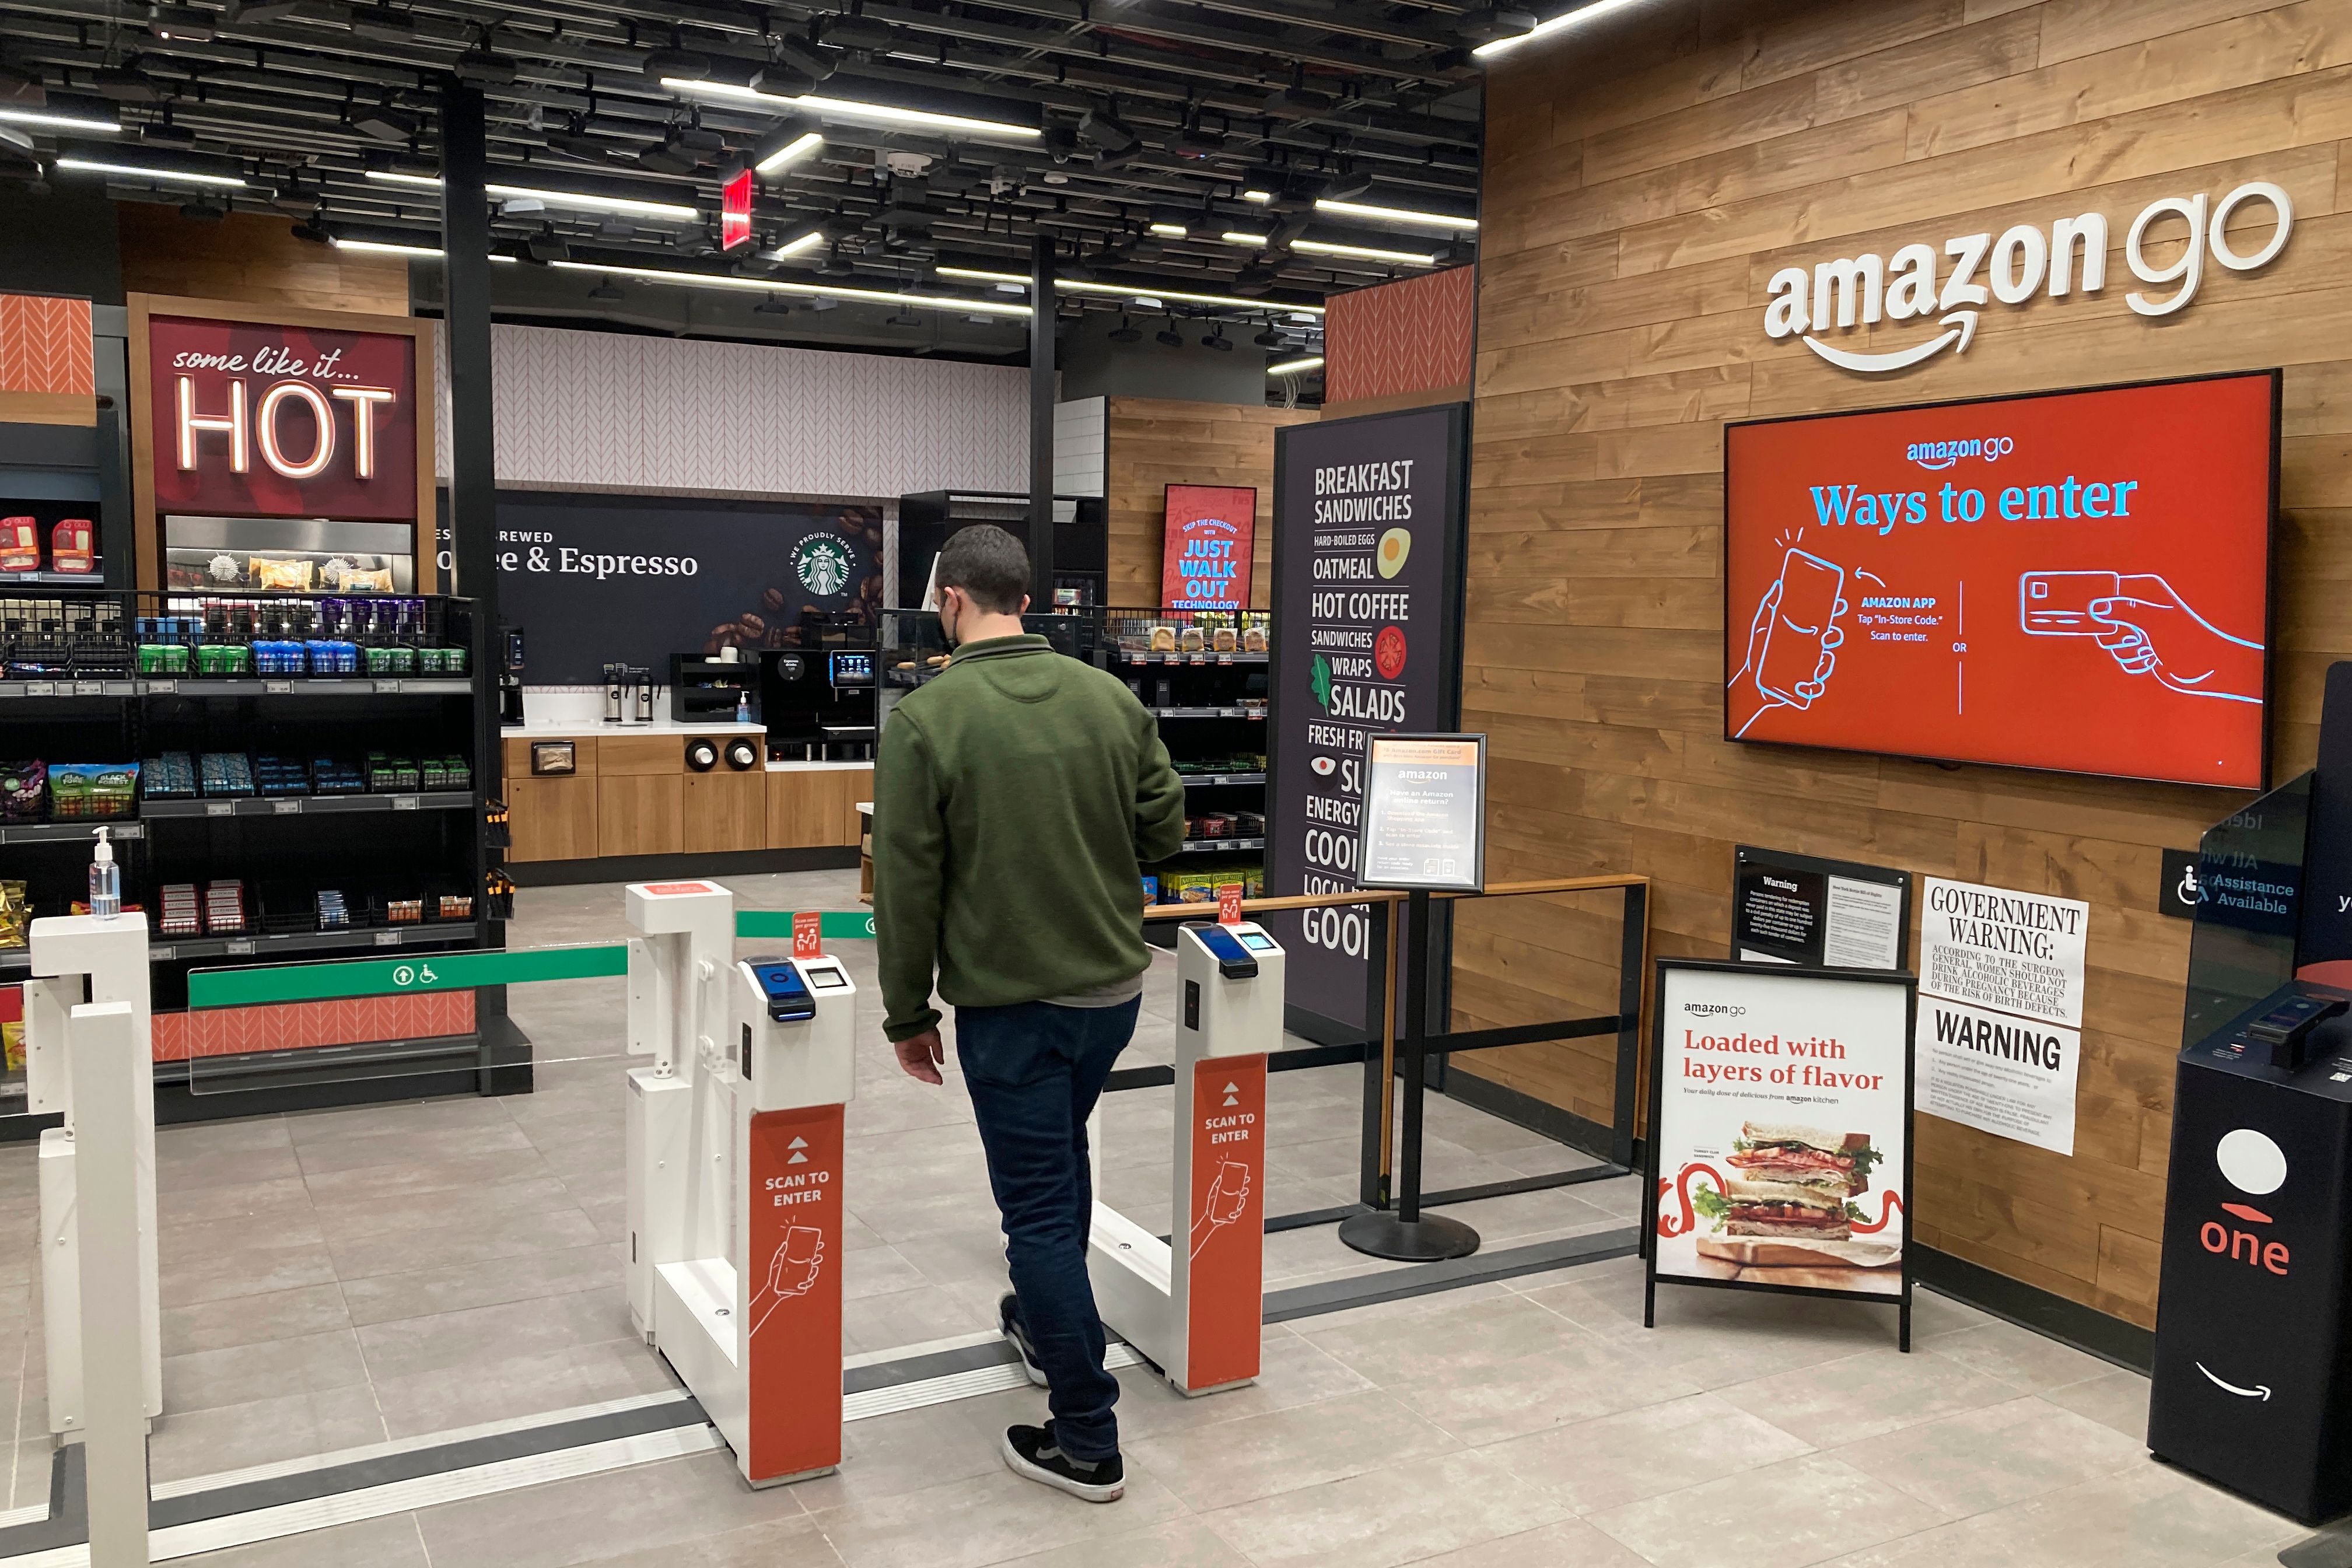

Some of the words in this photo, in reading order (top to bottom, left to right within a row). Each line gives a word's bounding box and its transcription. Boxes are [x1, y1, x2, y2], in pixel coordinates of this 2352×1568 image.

[1763, 212, 2108, 339] amazon
[2125, 181, 2295, 317] go
[173, 351, 249, 372] some
[252, 346, 309, 376] like
[312, 348, 359, 380] it...
[174, 373, 397, 480] HOT
[1907, 438, 1981, 461] amazon
[1984, 436, 2014, 463] go
[1315, 459, 1413, 496] BREAKFAST
[1314, 494, 1412, 524] SANDWICHES
[1809, 484, 1927, 536] Ways
[1938, 481, 1986, 523] to
[1998, 475, 2138, 521] enter
[495, 530, 553, 543] REWED
[1182, 521, 1196, 533] SKIP
[1209, 519, 1238, 534] CHECKOUT
[790, 546, 800, 559] WE
[799, 531, 835, 547] PROUDLY
[836, 537, 856, 559] SERVE
[1184, 539, 1234, 558] JUST
[1314, 534, 1357, 547] HARD-BOILED
[1357, 533, 1375, 545] EGGS
[526, 546, 551, 572] &
[558, 547, 698, 580] Espresso
[1178, 559, 1237, 578] WALK
[1312, 557, 1374, 580] OATMEAL
[1185, 579, 1228, 598] OUT
[1171, 600, 1240, 610] TECHNOLOGY
[1311, 592, 1346, 619] HOT
[1348, 592, 1409, 621] COFFEE
[1861, 597, 1911, 608] AMAZON
[1912, 597, 1937, 609] APP
[1857, 613, 1873, 625] Tap
[1311, 629, 1373, 649] SANDWICHES
[1870, 631, 1891, 641] Scan
[1892, 631, 1902, 640] to
[1903, 632, 1929, 642] enter.
[1952, 642, 1967, 653] OR
[1331, 656, 1372, 678] WRAPS
[1329, 684, 1406, 723] SALADS
[1308, 724, 1345, 748] FRESH
[1397, 769, 1448, 780] amazon
[1390, 789, 1409, 797] Have
[1422, 790, 1454, 798] Amazon
[1306, 794, 1361, 827] ENERGY
[1763, 876, 1798, 892] Warning
[2213, 873, 2294, 897] Assistance
[1931, 886, 2080, 935] GOVERNMENT
[2217, 892, 2287, 915] Available
[1949, 916, 2054, 961] WARNING:
[1932, 944, 1982, 961] ACCORDING
[1985, 954, 1996, 965] TO
[1999, 957, 2018, 970] THE
[2021, 961, 2065, 978] SURGEON
[1932, 953, 1973, 970] GENERAL,
[1976, 962, 2007, 977] WOMEN
[2009, 969, 2046, 985] SHOULD
[2048, 978, 2067, 989] NOT
[1931, 971, 1964, 986] DURING
[1965, 978, 2016, 997] PREGNANCY
[2018, 991, 2059, 1007] BECAUSE
[1932, 962, 1958, 976] DRINK
[1961, 968, 2010, 987] ALCOHOLIC
[2011, 978, 2065, 998] BEVERAGES
[1684, 1002, 1728, 1014] amazon
[1729, 1005, 1746, 1017] go
[1931, 980, 1941, 991] OF
[1944, 982, 1961, 995] THE
[1961, 986, 1981, 1000] RISK
[1982, 991, 1993, 1002] OF
[1994, 995, 2022, 1009] BIRTH
[2024, 1001, 2068, 1019] DEFECTS.
[1684, 1029, 1780, 1055] Loaded
[1786, 1037, 1846, 1059] with
[1935, 1009, 2062, 1072] WARNING
[1683, 1056, 1763, 1084] layers
[1769, 1063, 1797, 1084] of
[1802, 1065, 1884, 1091] flavor
[1740, 1091, 1768, 1100] delicious
[1812, 1096, 1839, 1104] kitchen
[1205, 1115, 1237, 1130] SCAN
[1238, 1112, 1255, 1125] TO
[1212, 1129, 1249, 1144] ENTER
[765, 1174, 806, 1191] SCAN
[808, 1171, 830, 1184] TO
[774, 1189, 822, 1207] ENTER
[2200, 1221, 2290, 1276] one
